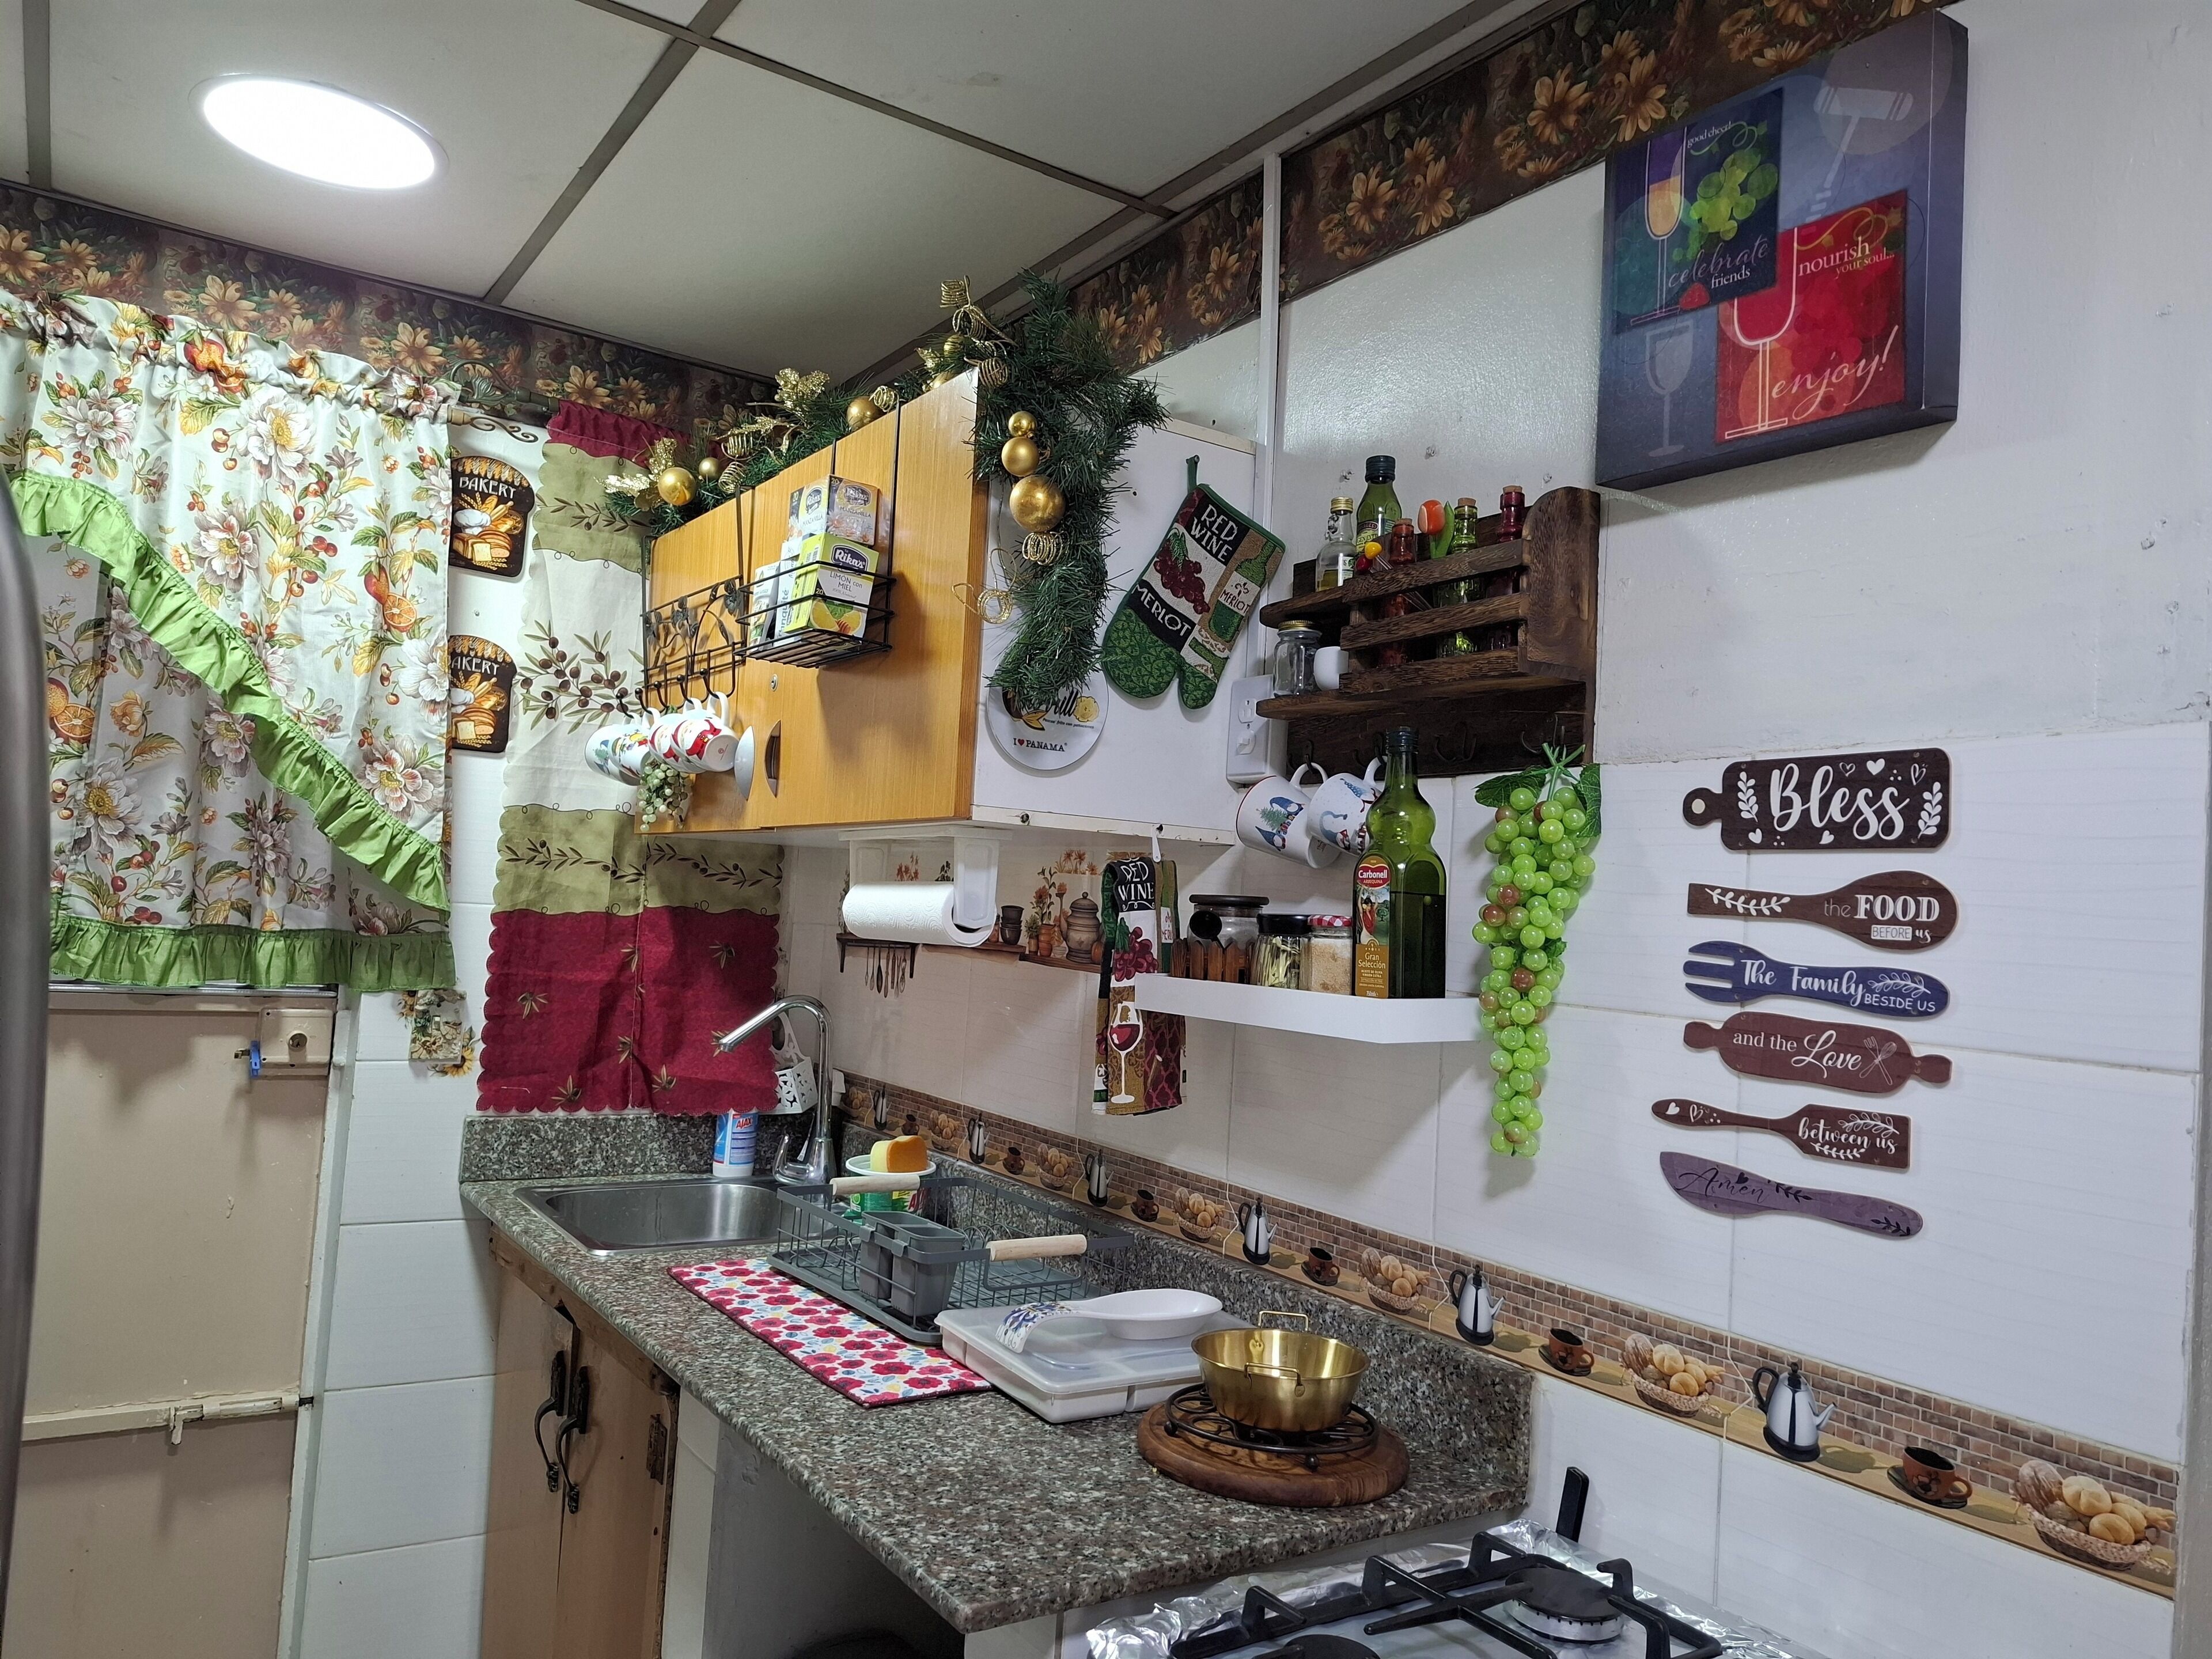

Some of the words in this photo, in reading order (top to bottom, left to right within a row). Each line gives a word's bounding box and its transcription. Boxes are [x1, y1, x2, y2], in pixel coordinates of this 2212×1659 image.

[1687, 130, 1707, 148] good
[1668, 235, 1768, 287] celebrate
[1798, 236, 1870, 276] nourish
[1711, 265, 1751, 289] friends
[1834, 260, 1863, 279] your
[1772, 325, 1899, 420] enjoy!
[460, 477, 516, 499] BAKERY
[793, 491, 798, 502] 20
[840, 506, 871, 518] MANZANILLA
[1200, 504, 1238, 541] RED
[1191, 516, 1232, 562] WINE
[838, 582, 852, 592] MIEL
[1131, 583, 1192, 637] MERLOT
[1219, 589, 1251, 614] MERLOT
[452, 656, 499, 675] AKERY
[1026, 740, 1065, 752] PANAMA
[1770, 763, 1910, 840] Bless
[1120, 861, 1149, 882] RED
[1358, 870, 1387, 878] Carbonell
[1118, 882, 1154, 902] WINE
[1823, 900, 1851, 918] the
[1854, 895, 1940, 922] FOOD
[1872, 926, 1911, 940] BEFORE
[1915, 927, 1932, 944] us
[1358, 959, 1386, 969] Selección
[1365, 952, 1380, 960] Gran
[1740, 960, 1777, 986] The
[1789, 966, 1866, 1007] Family
[1865, 993, 1913, 1010] BESIDE
[1918, 1000, 1936, 1012] US
[1733, 1031, 1764, 1048] and
[1770, 1034, 1797, 1052] the
[1791, 1030, 1862, 1078] Love
[736, 1117, 752, 1129] AJAX
[1798, 1117, 1870, 1149] between
[1876, 1135, 1898, 1154] us
[1672, 1168, 1769, 1204] Amen
